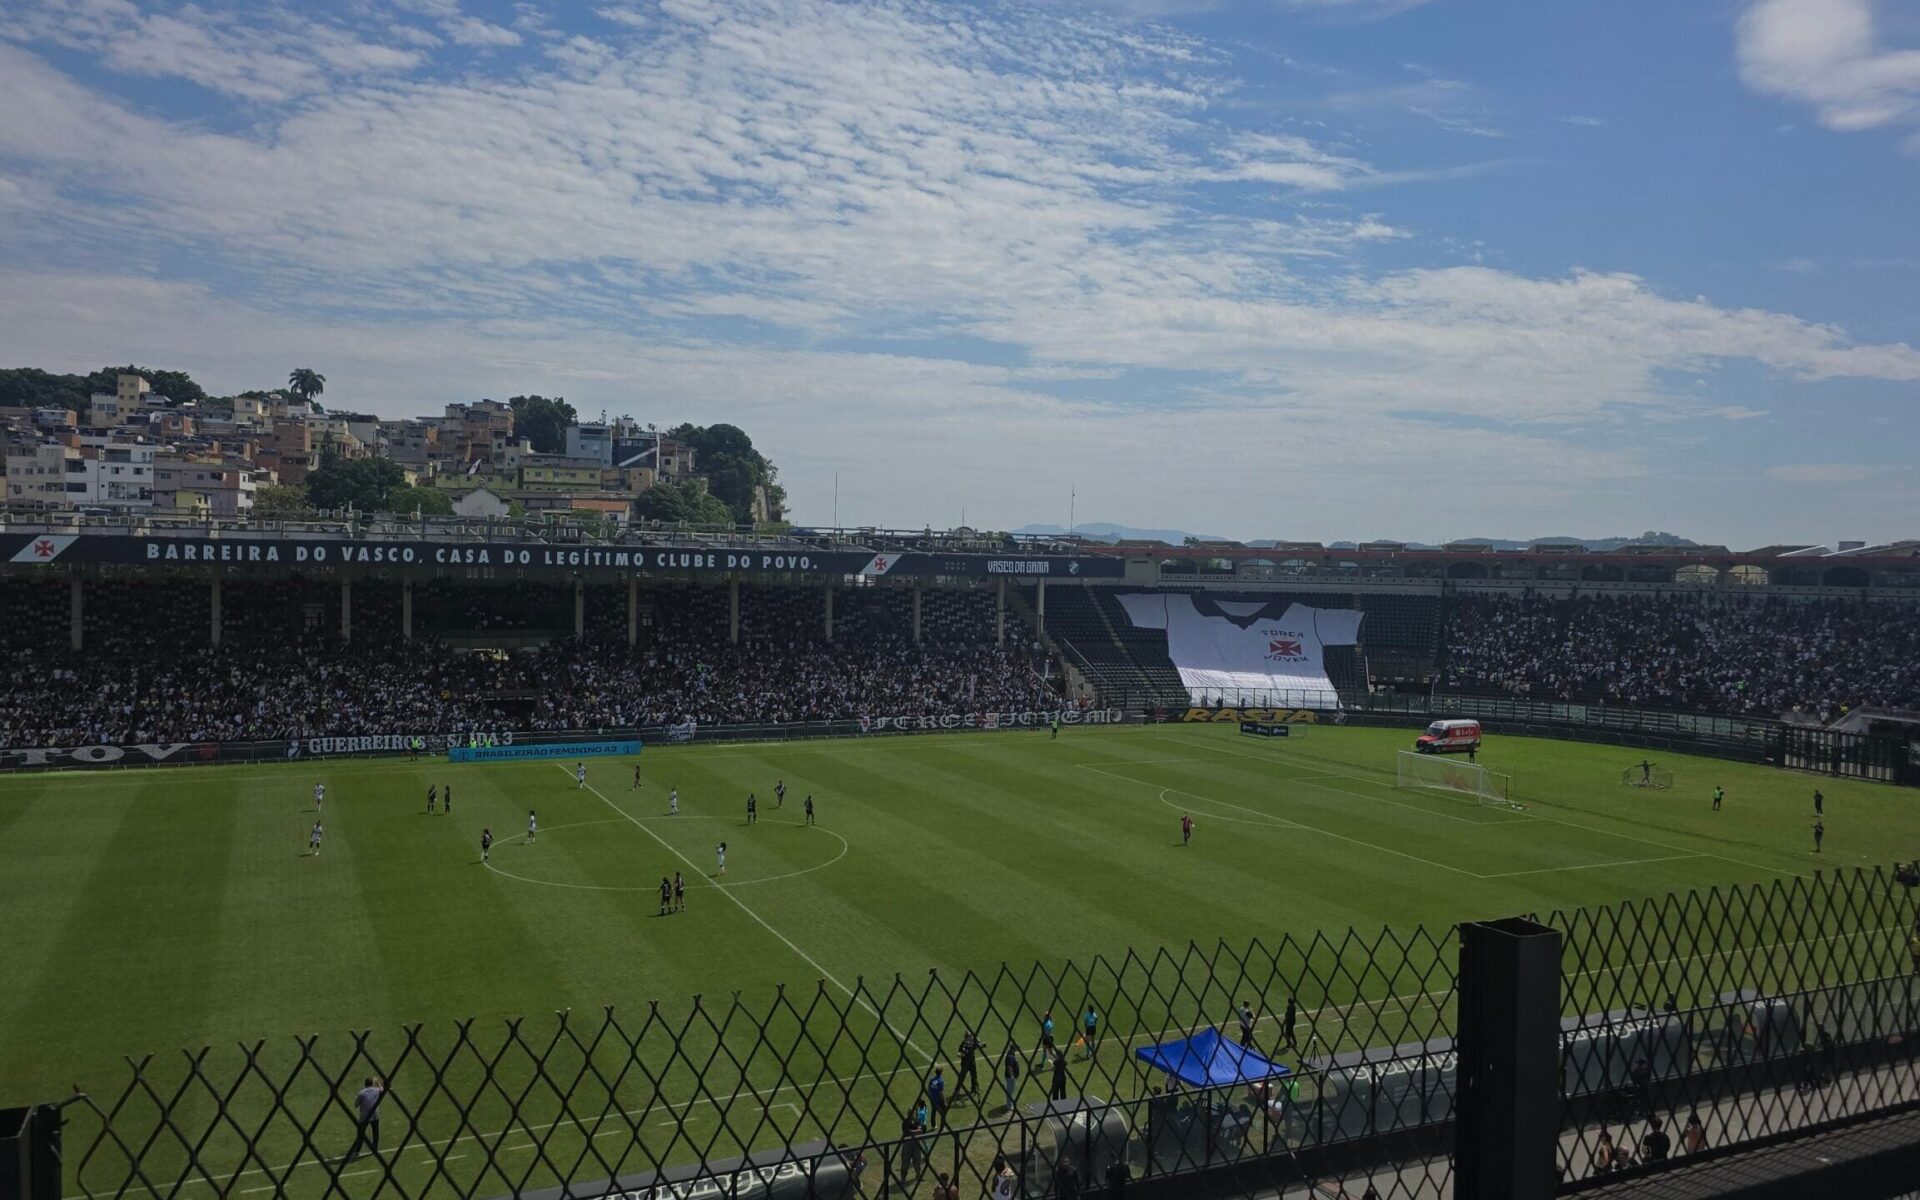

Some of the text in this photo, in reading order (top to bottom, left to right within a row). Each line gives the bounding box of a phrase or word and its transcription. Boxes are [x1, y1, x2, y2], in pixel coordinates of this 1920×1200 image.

[147, 543, 818, 570] BARREIRA DO VASCO, CASA DO LEGÍTIMO CLUBE DO POVO.
[987, 560, 1049, 573] VASCO DA GAMA
[1183, 708, 1316, 723] RASTA
[309, 734, 427, 753] GUERREIROS
[502, 731, 513, 746] 3
[475, 745, 617, 759] BRASILEIRÃO FEMININO A2
